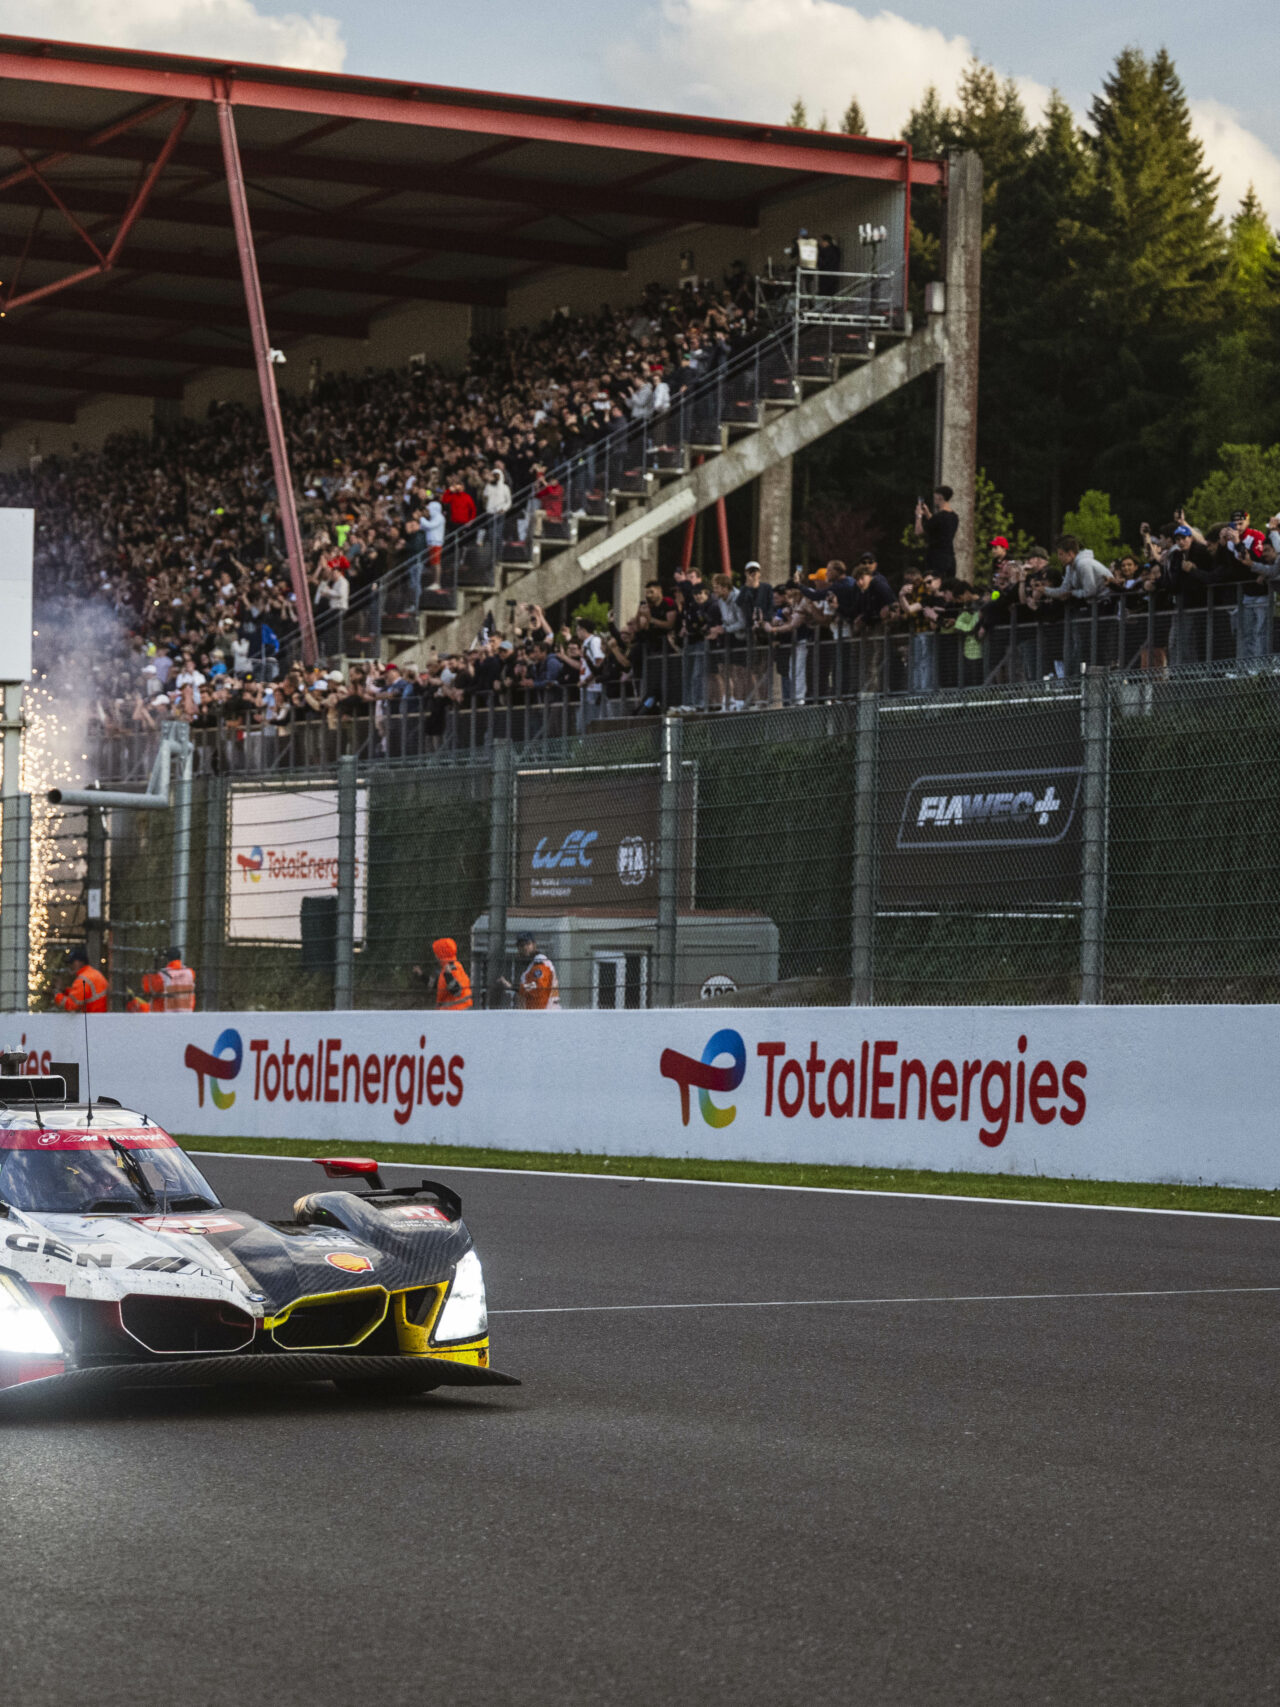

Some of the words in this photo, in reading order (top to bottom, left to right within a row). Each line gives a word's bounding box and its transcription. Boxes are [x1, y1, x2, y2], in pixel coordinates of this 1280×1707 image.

[249, 1035, 465, 1125] TotalEnergies
[756, 1034, 1088, 1148] TotalEnergies
[5, 1233, 113, 1268] GEN
